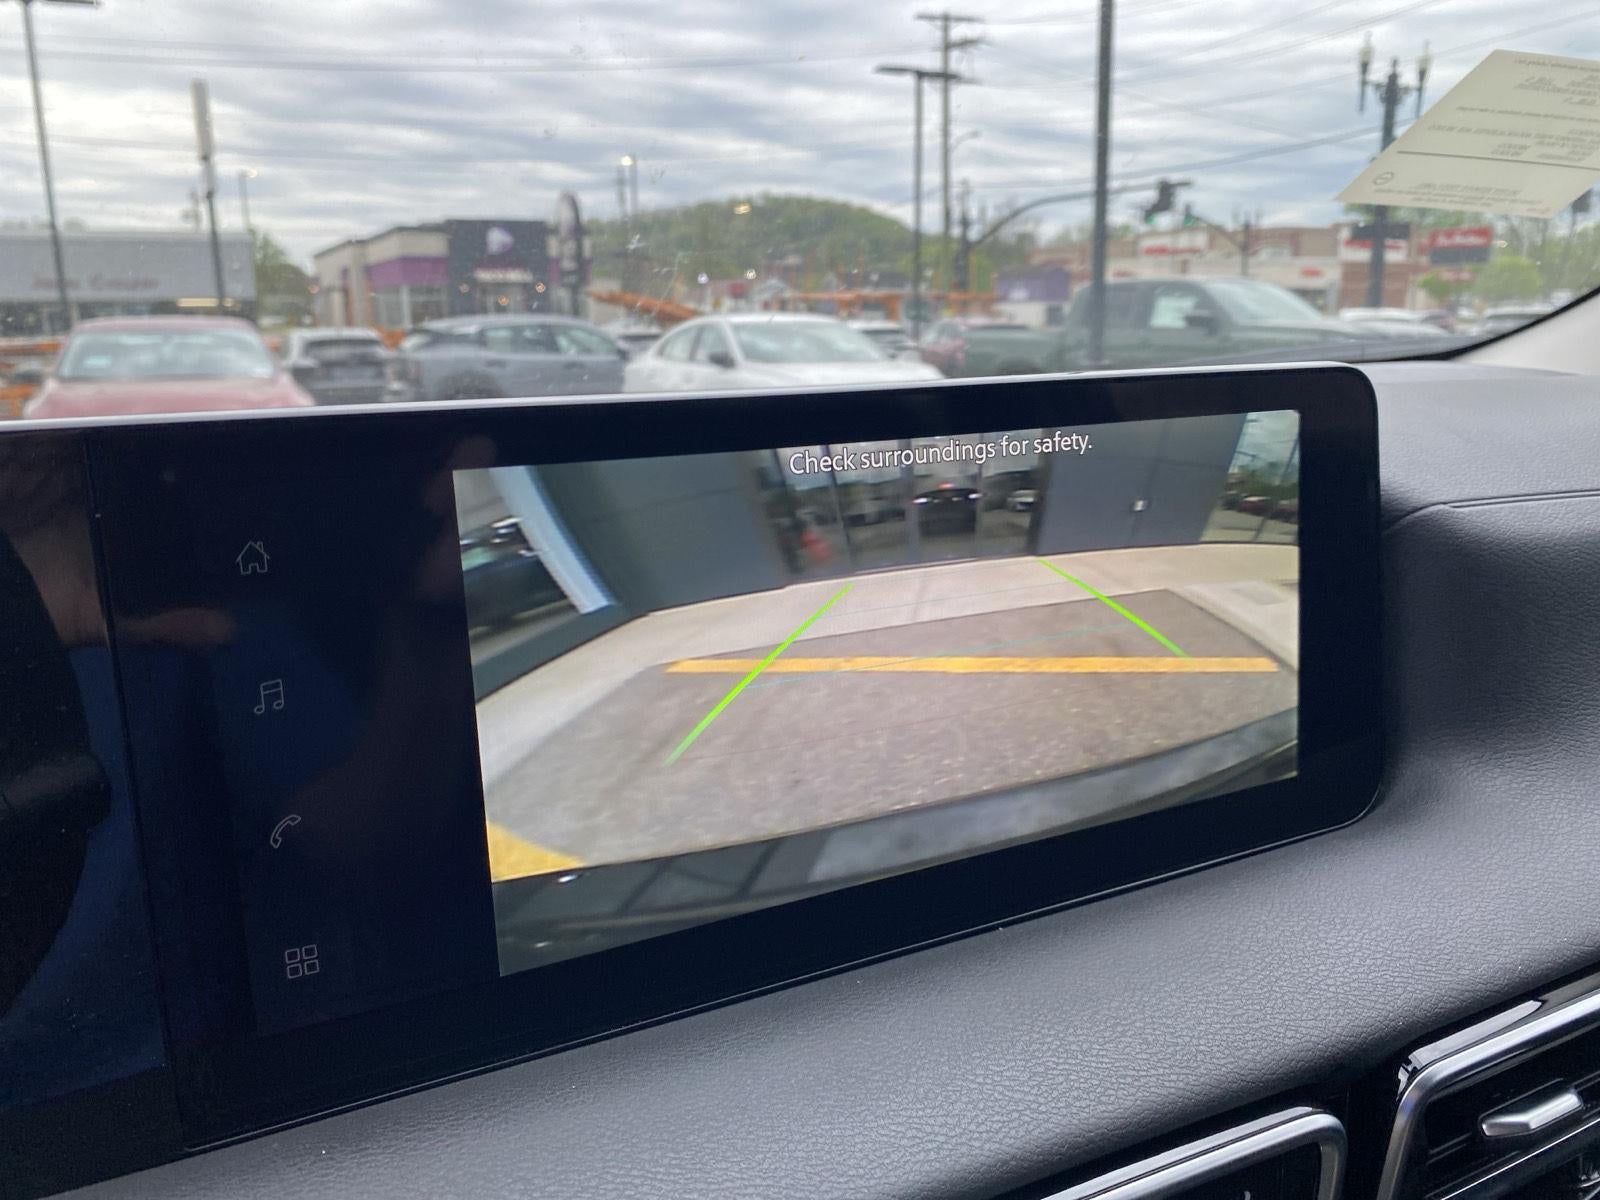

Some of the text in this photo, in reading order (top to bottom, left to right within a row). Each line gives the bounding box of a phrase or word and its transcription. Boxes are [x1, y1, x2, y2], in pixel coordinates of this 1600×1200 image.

[789, 431, 1093, 475] Check surroundings for safety.
